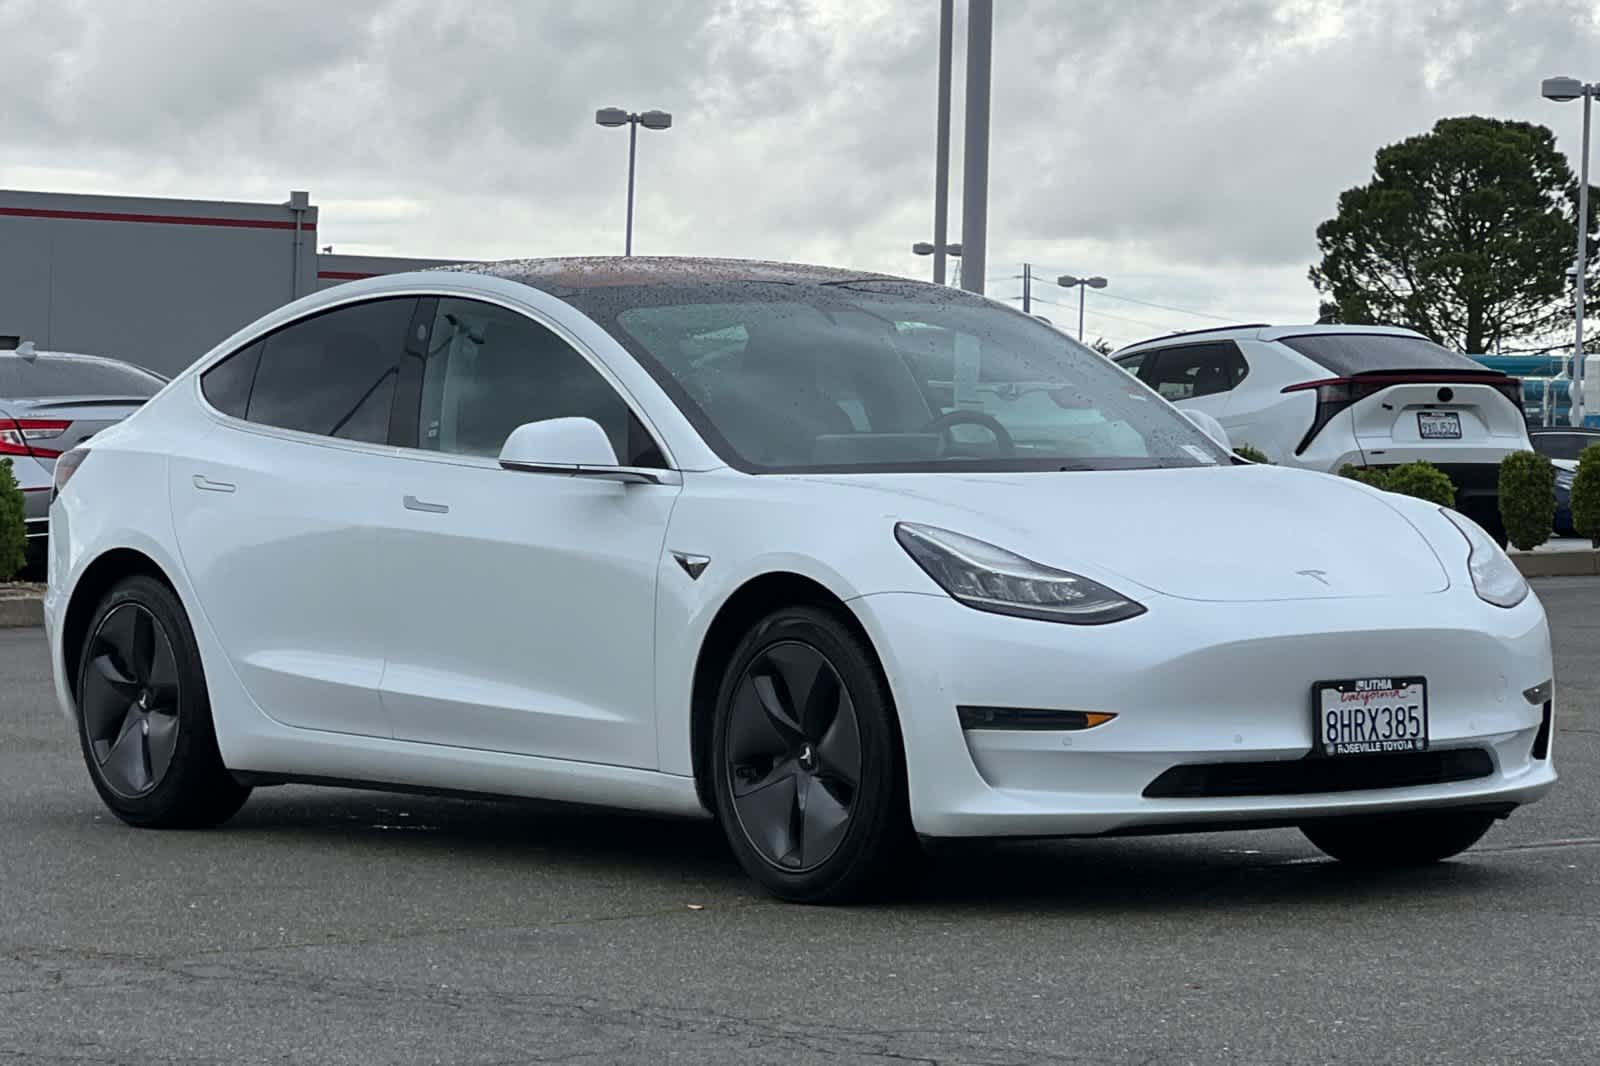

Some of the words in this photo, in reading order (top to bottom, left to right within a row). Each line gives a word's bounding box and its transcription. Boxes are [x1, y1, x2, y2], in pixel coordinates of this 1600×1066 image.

[1364, 679, 1392, 690] LITHIA
[1326, 705, 1420, 743] 8HRX385
[1337, 742, 1381, 754] ROSEVILLE
[1382, 740, 1413, 751] TOYOTA
